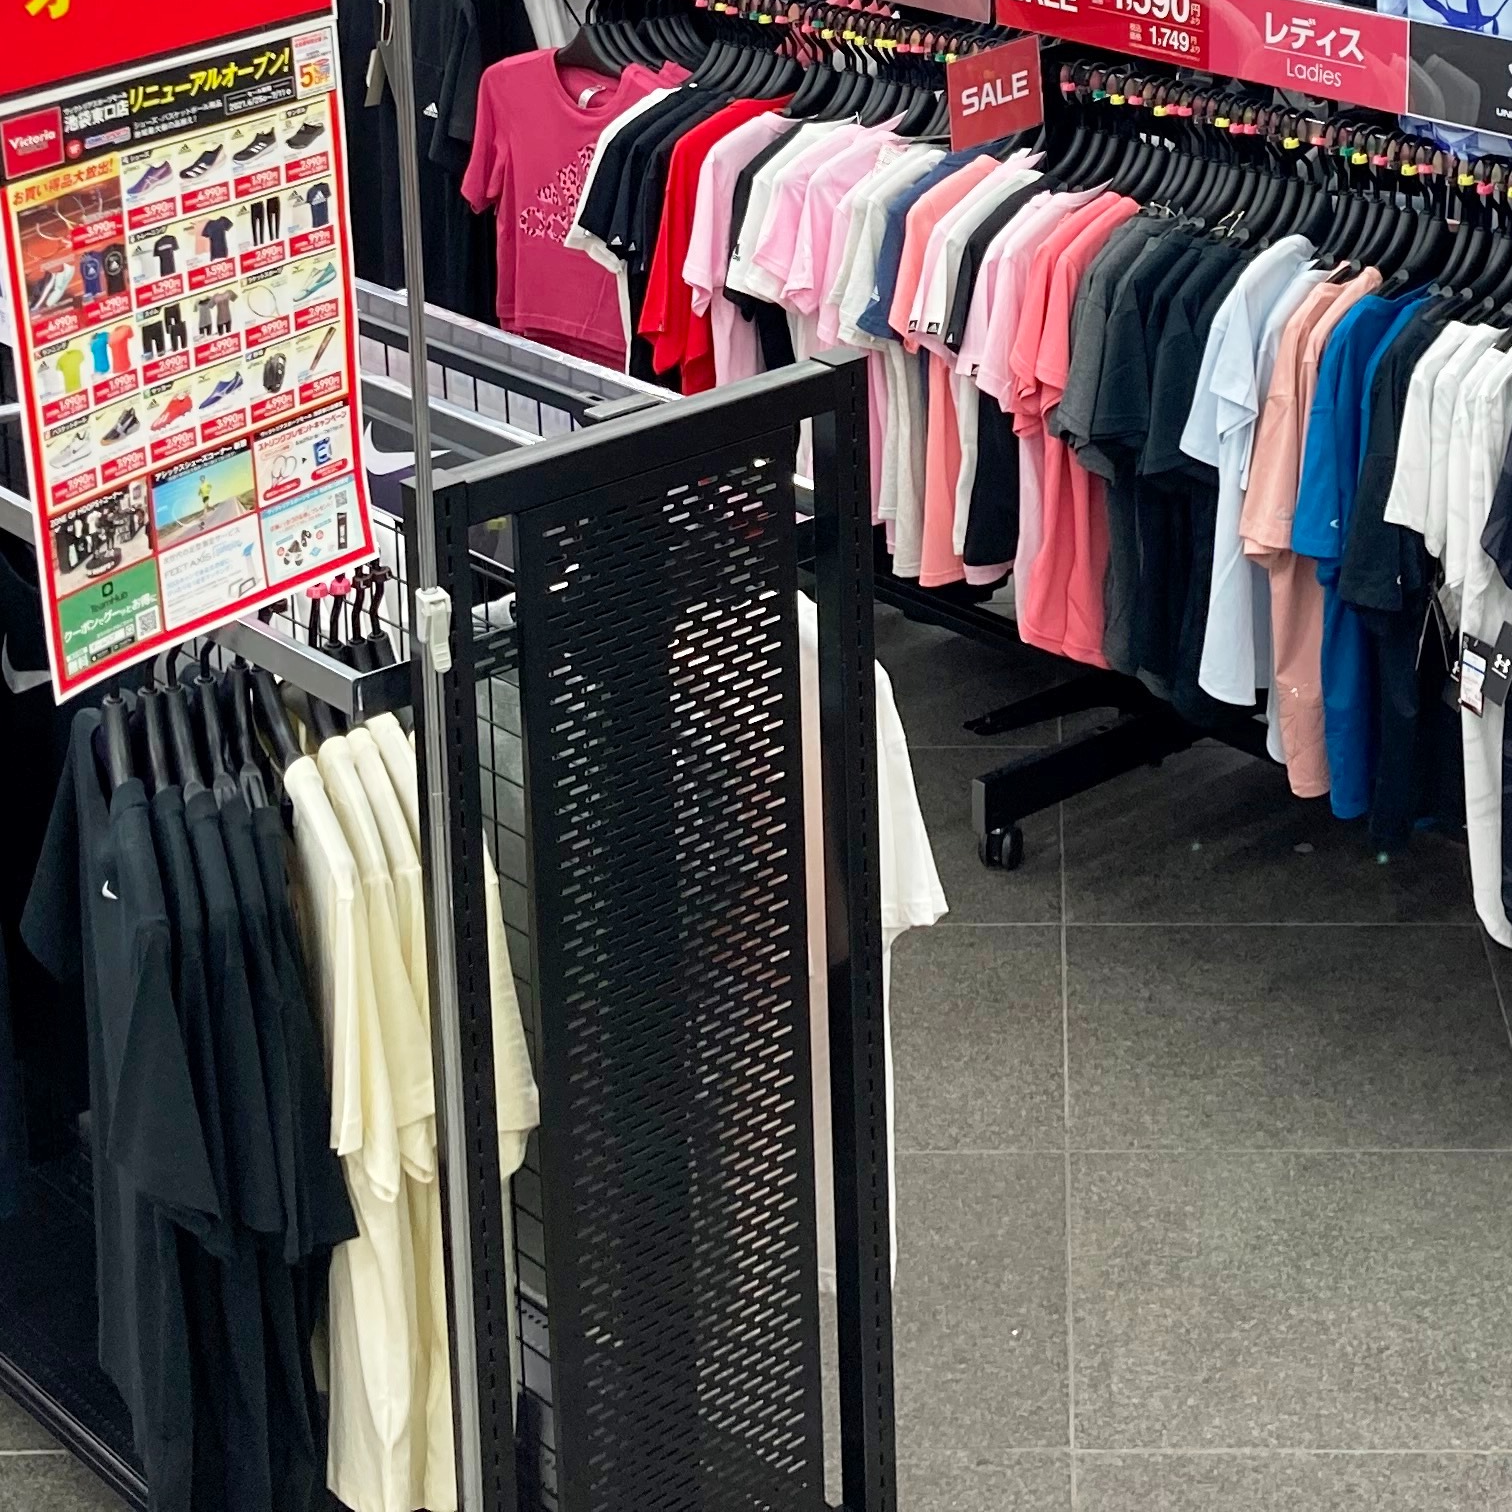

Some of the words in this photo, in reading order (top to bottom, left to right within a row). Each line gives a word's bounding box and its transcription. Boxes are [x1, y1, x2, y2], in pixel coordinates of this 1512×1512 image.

[1149, 26, 1190, 52] 1,749
[1265, 11, 1365, 62] レディス
[129, 47, 290, 113] リニューアルオープン!
[1286, 61, 1343, 88] Ladies
[961, 70, 1030, 117] SALE
[9, 129, 56, 150] Victoria
